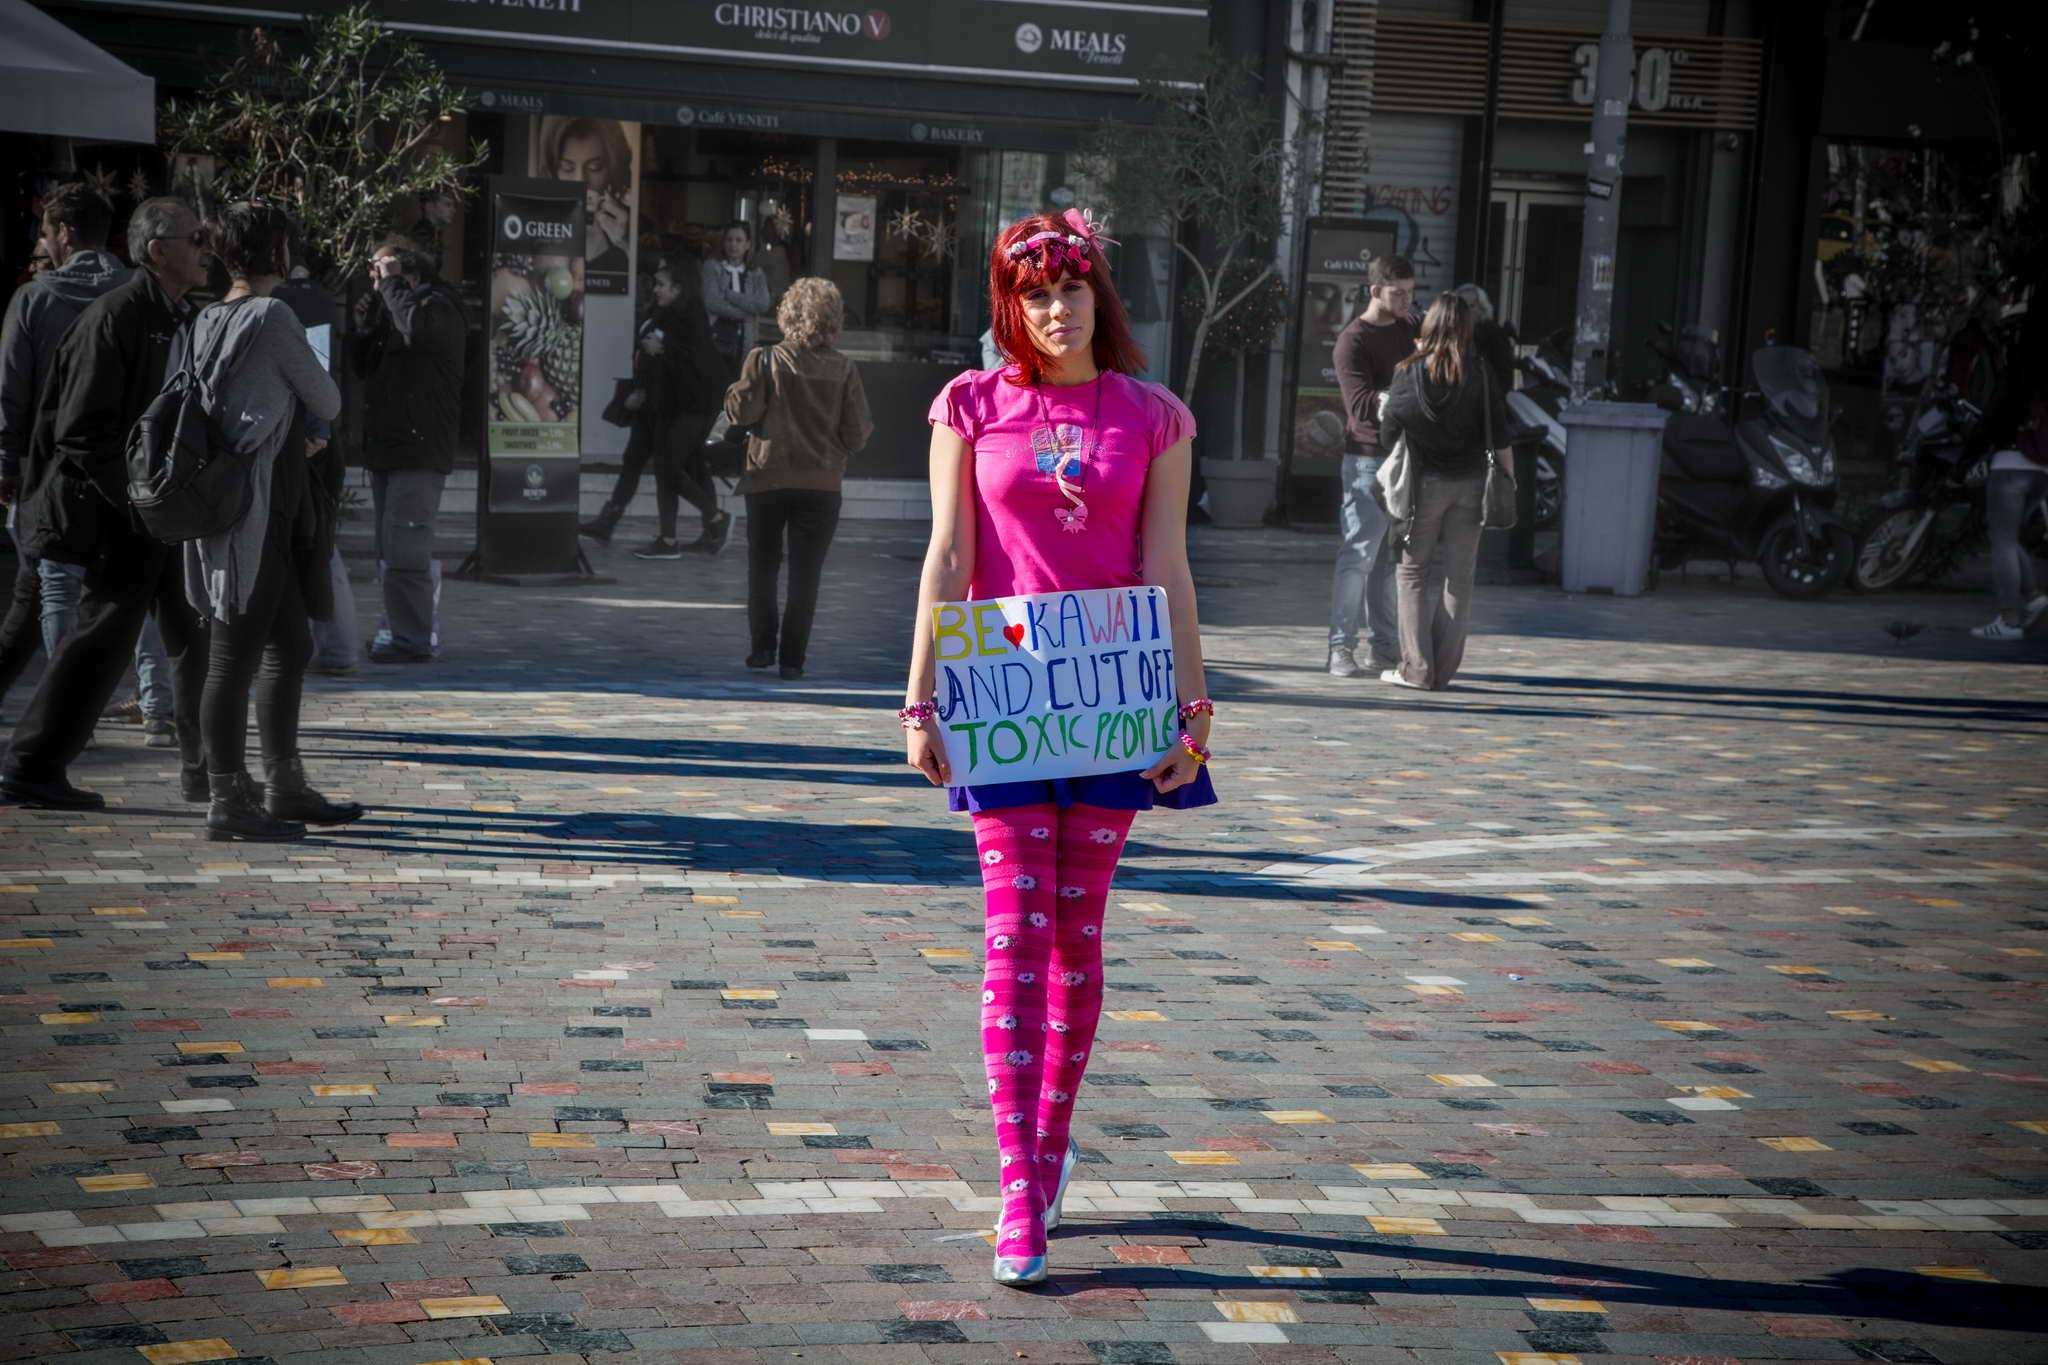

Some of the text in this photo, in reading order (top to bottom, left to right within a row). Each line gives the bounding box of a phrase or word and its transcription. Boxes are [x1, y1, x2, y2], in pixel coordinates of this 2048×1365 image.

[714, 2, 886, 37] CHRISTIANO V
[1049, 28, 1127, 54] MEALS
[500, 94, 544, 107] MEALS
[728, 111, 779, 128] VENETI
[930, 127, 985, 143] BAKERY
[525, 220, 573, 239] GREEN
[932, 603, 1007, 661] BE
[938, 649, 1174, 722] AND CUT OFF
[950, 704, 1177, 774] TOXIC PEOPLE
